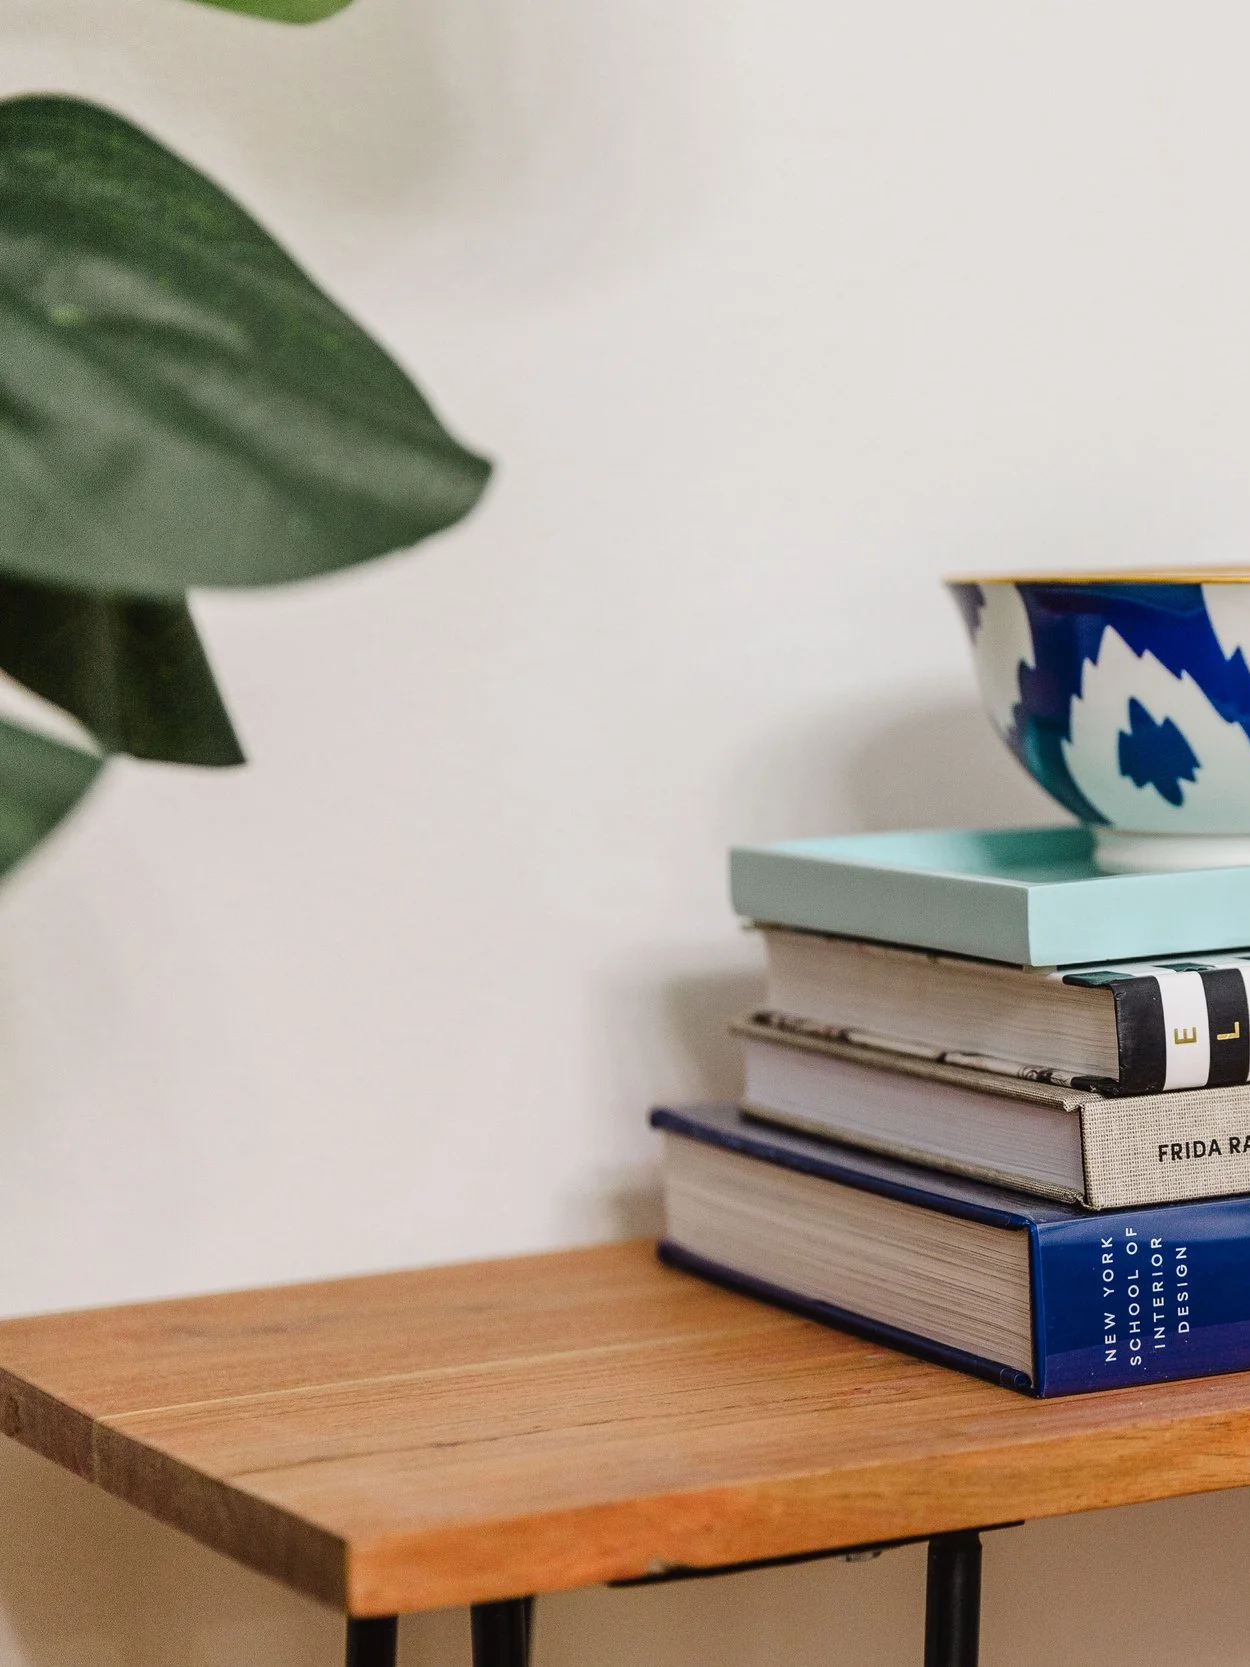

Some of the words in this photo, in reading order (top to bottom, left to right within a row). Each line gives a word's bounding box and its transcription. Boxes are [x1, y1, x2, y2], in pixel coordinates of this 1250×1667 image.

[1157, 1138, 1223, 1163] FRIDA
[1101, 1236, 1115, 1298] YORK
[1125, 1227, 1138, 1255] OF
[1127, 1269, 1142, 1366] SCHOOL
[1150, 1237, 1166, 1349] INTERIOR
[1175, 1246, 1190, 1333] DESIGN
[1104, 1312, 1117, 1362] NEW
